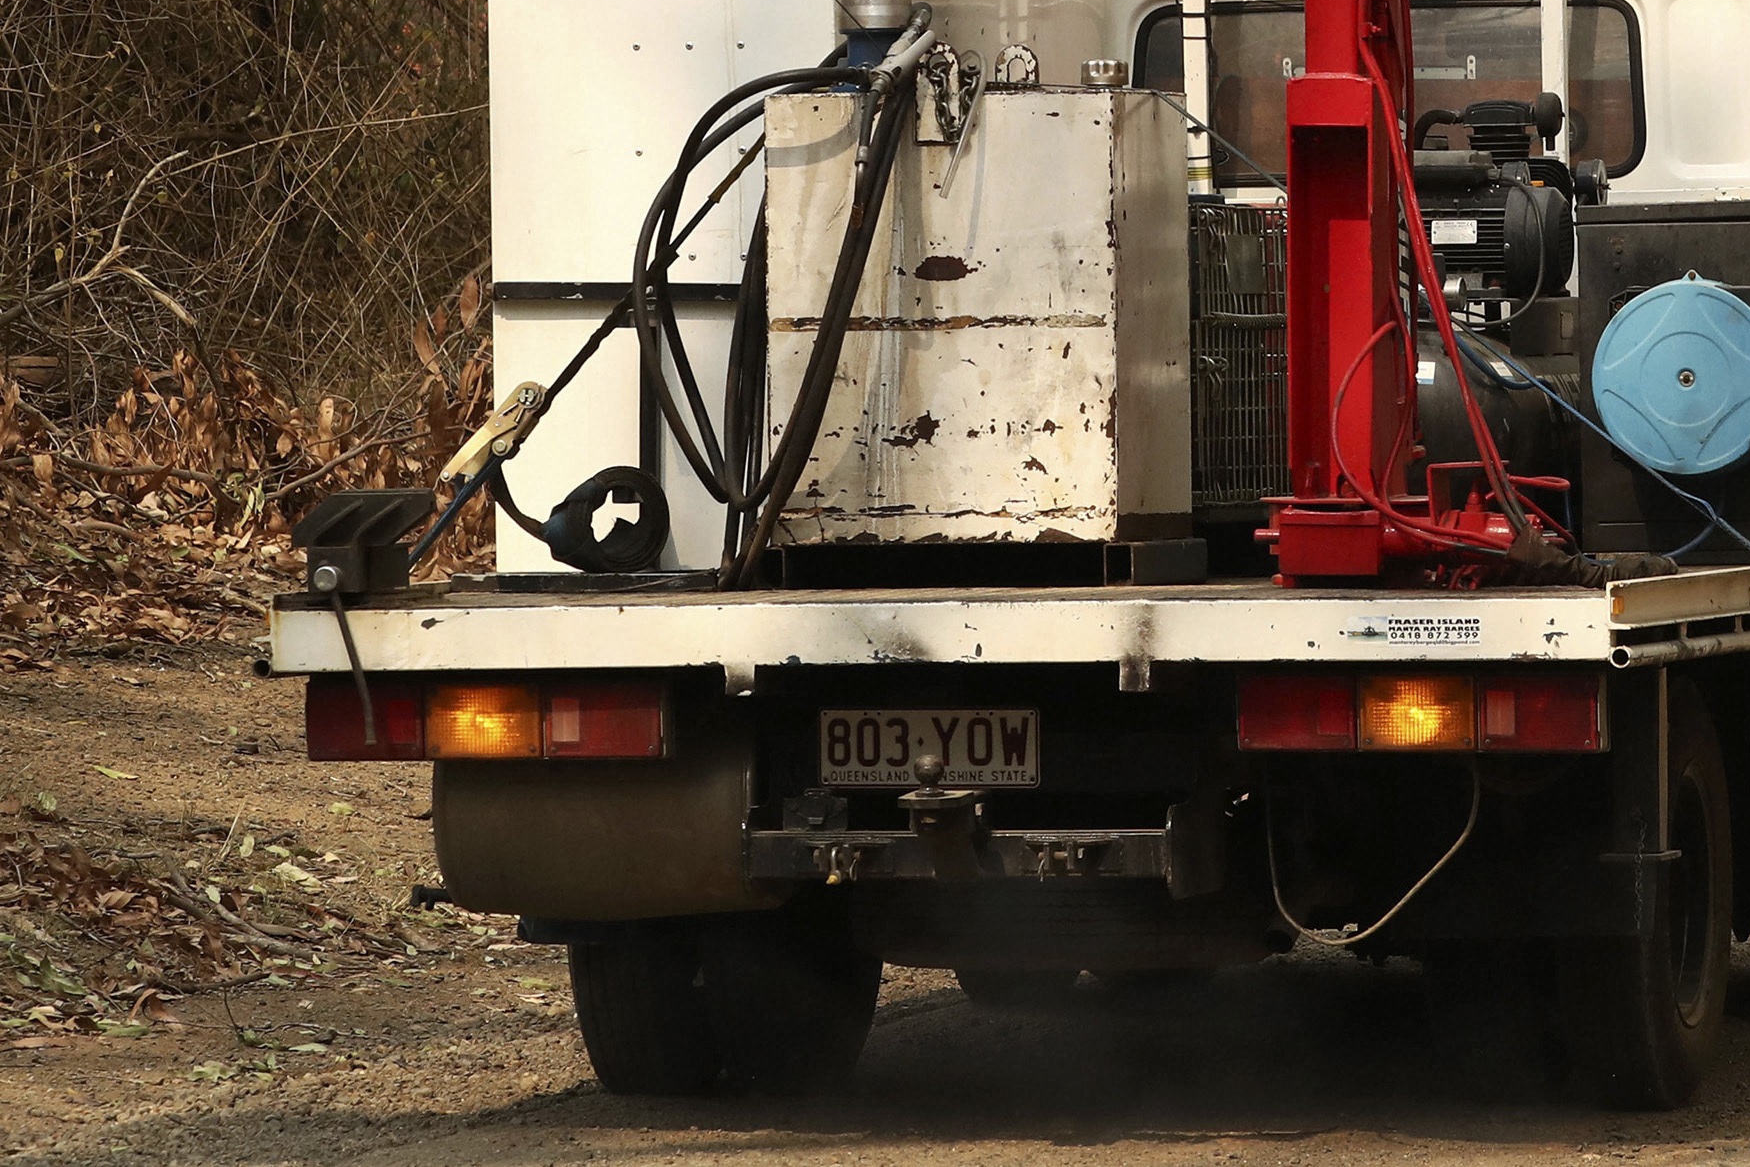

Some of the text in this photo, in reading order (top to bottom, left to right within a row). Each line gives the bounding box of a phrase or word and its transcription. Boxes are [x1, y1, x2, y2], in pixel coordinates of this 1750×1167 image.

[830, 770, 1027, 782] QUEENSLAND NSHINE STATE
